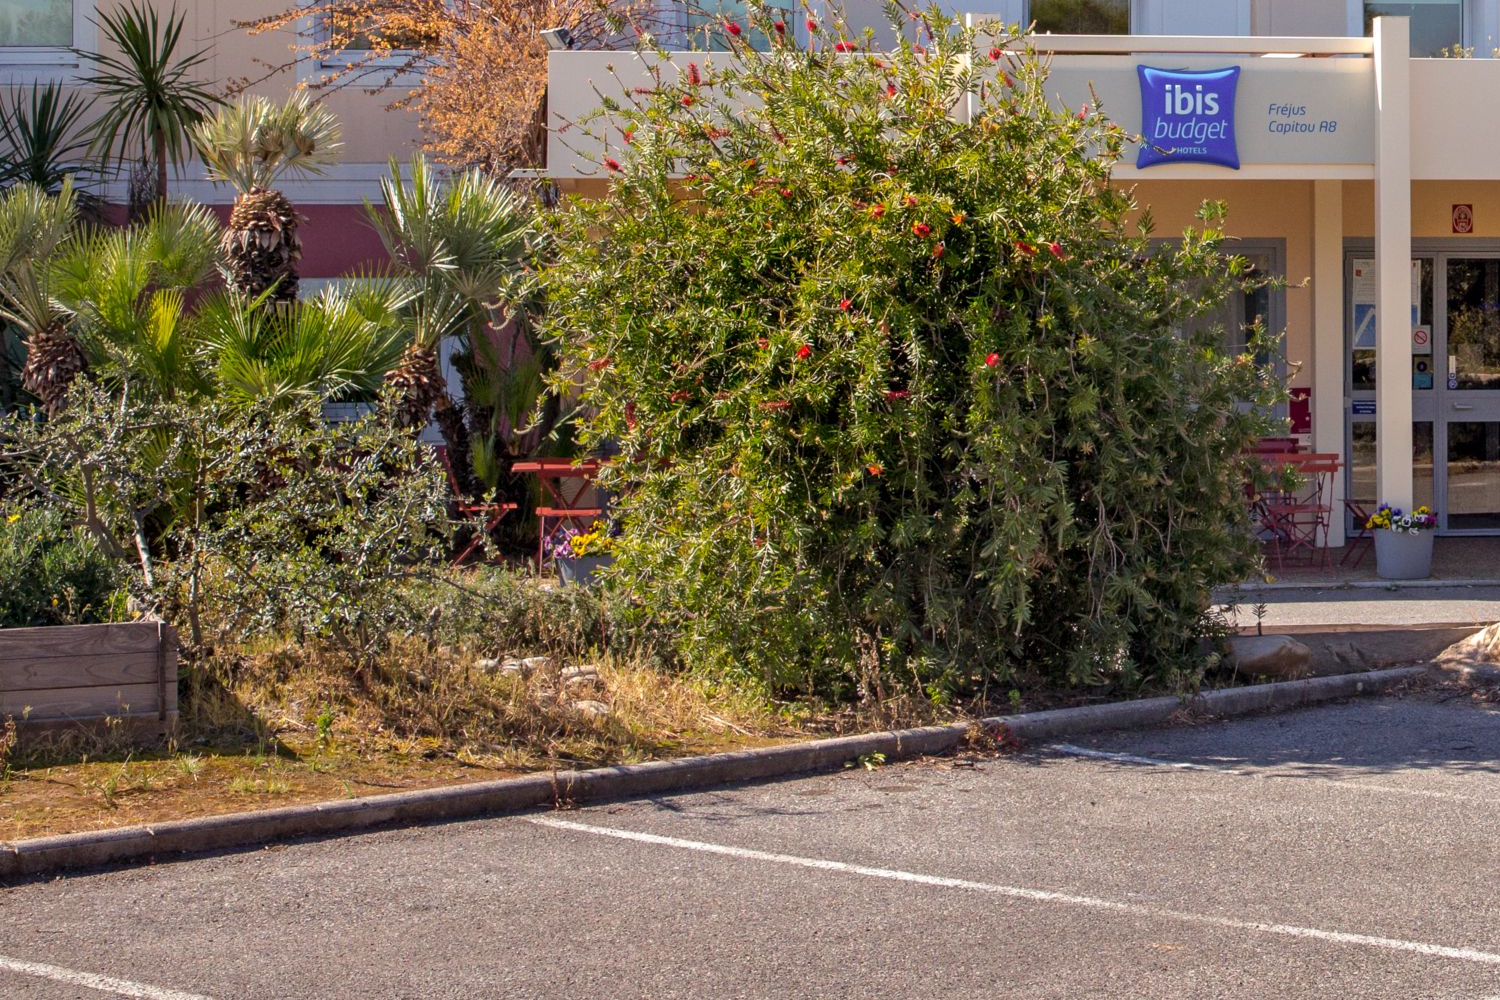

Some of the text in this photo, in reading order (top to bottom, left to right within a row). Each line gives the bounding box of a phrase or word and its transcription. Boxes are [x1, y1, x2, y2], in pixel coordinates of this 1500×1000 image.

[1165, 84, 1219, 115] ibis
[1268, 103, 1306, 118] Fréjus
[1154, 117, 1228, 144] budget
[1268, 120, 1337, 135] Capitou A8
